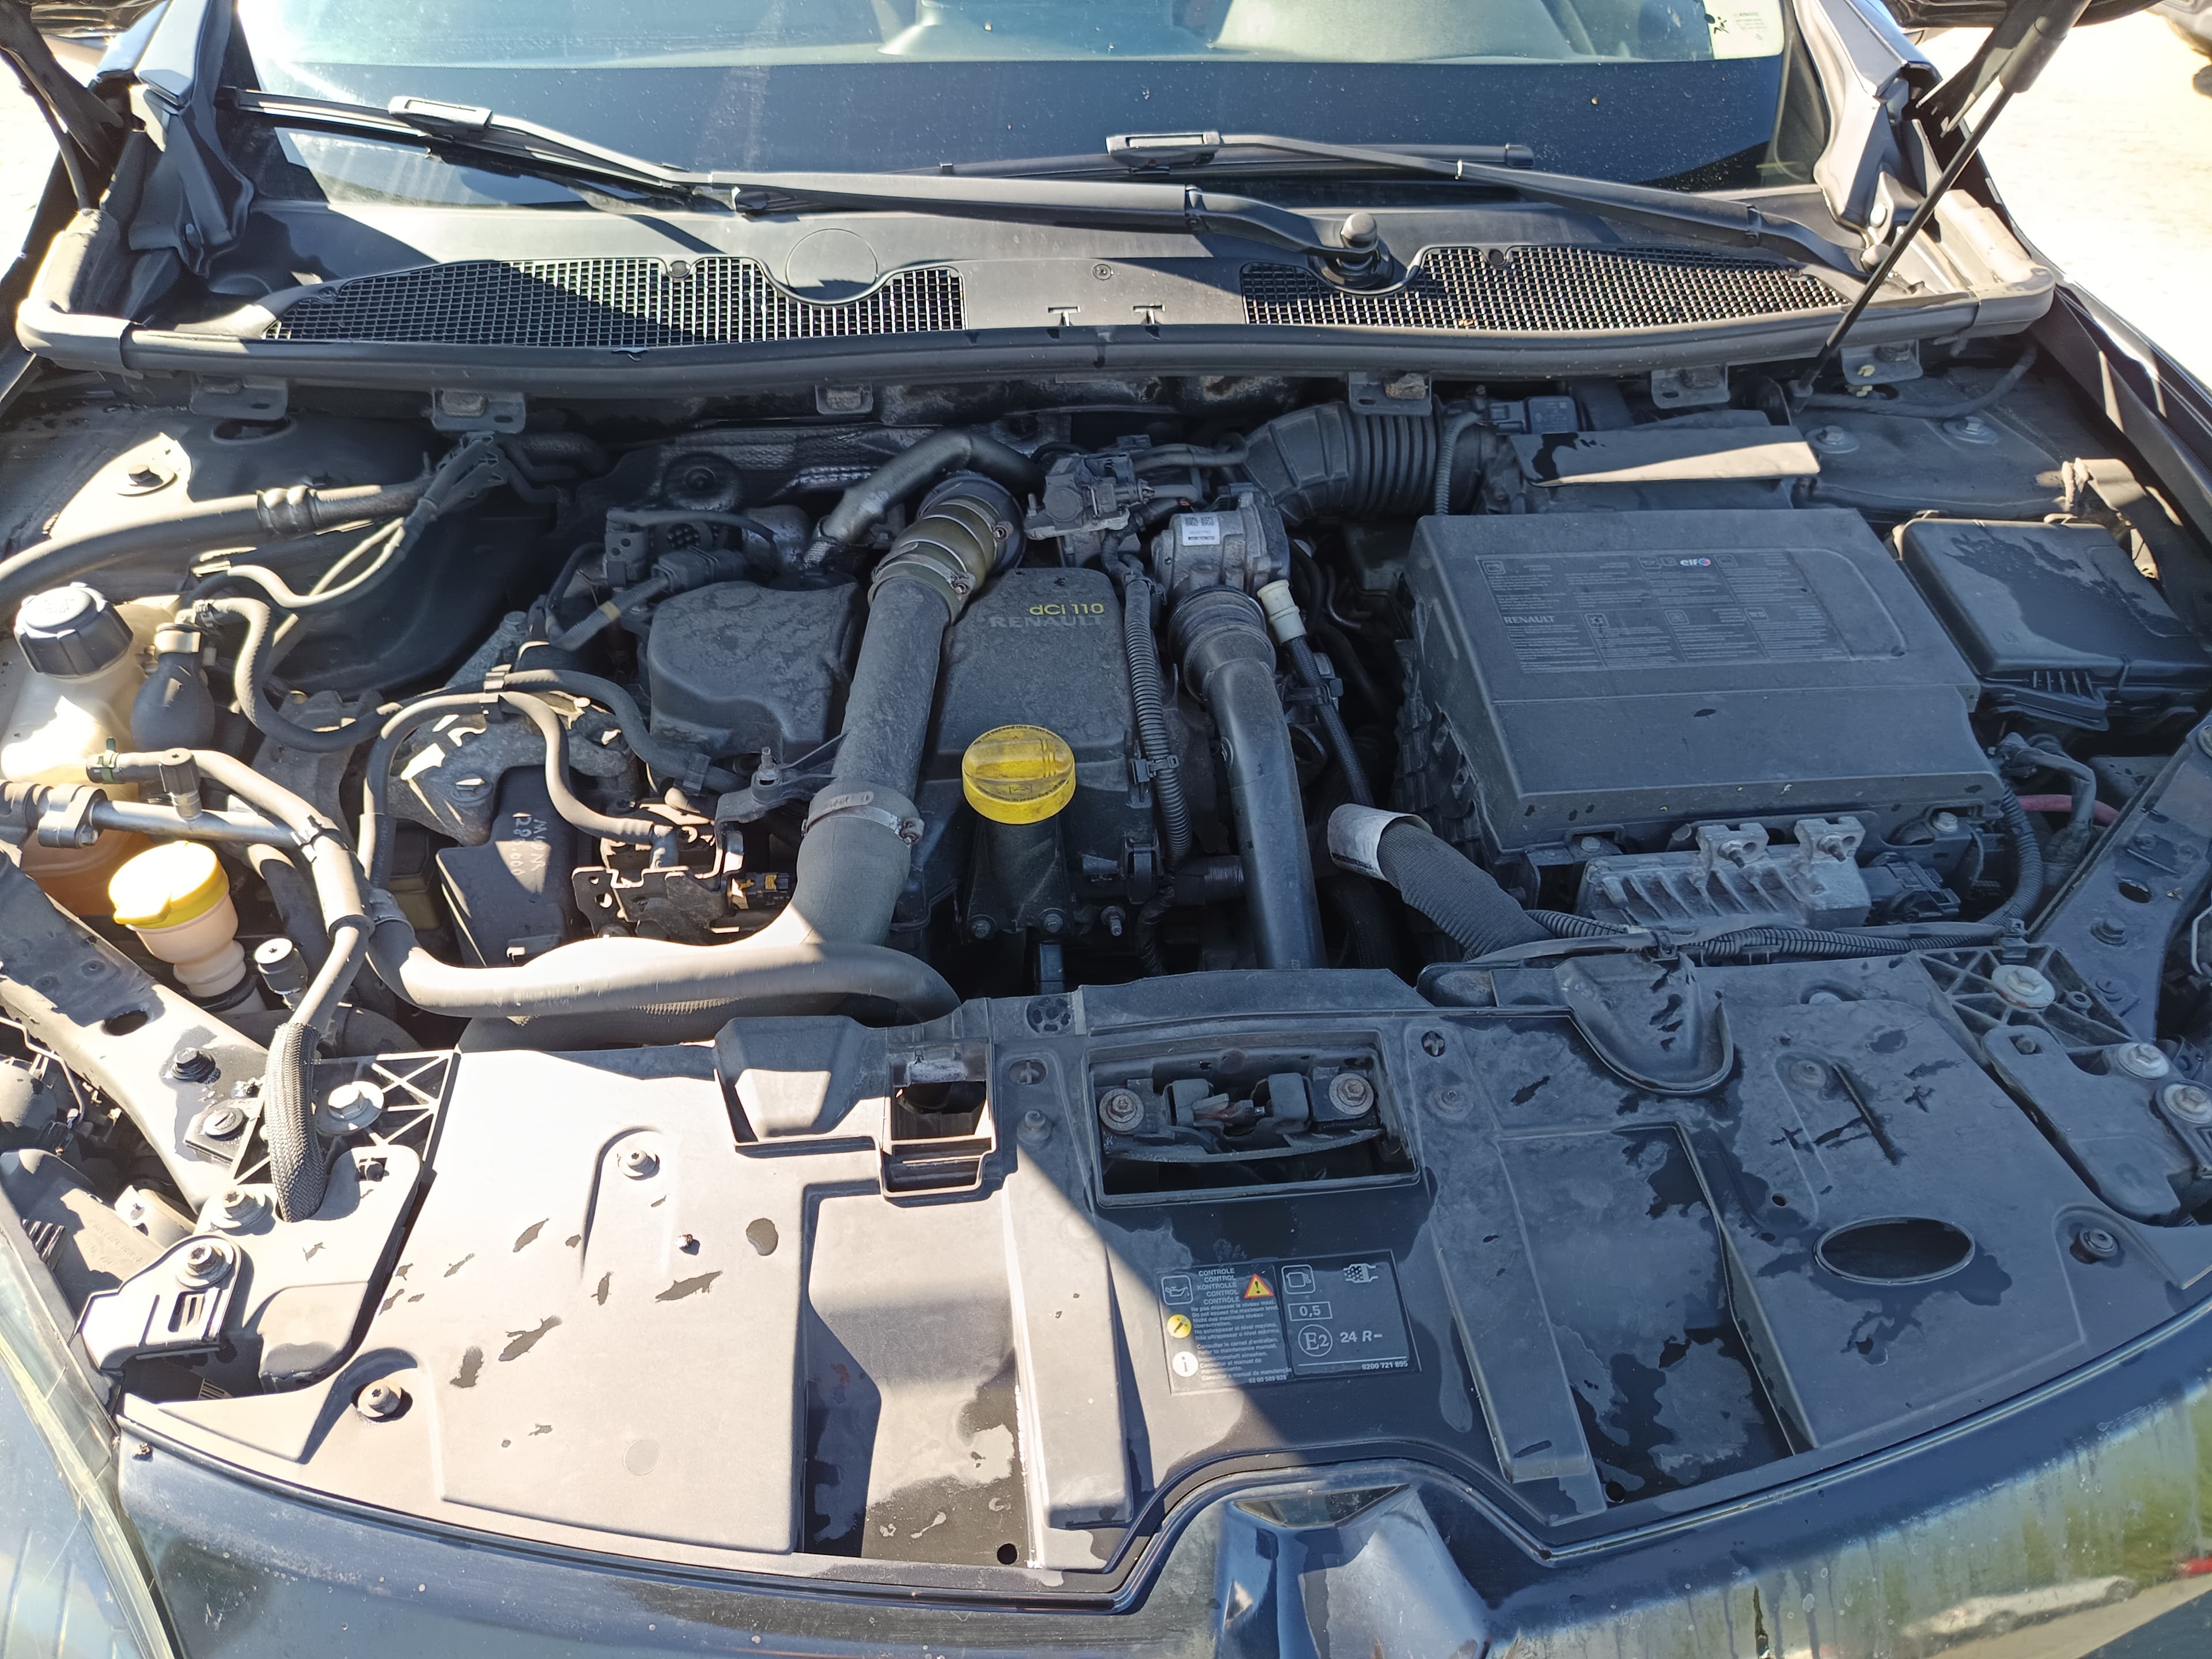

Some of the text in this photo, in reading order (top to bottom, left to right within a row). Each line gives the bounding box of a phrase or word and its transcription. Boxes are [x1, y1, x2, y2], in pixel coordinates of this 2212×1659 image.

[1029, 603, 1105, 615] dCi 110
[989, 615, 1105, 628] RENAULT
[1503, 616, 1555, 624] RENAULT
[991, 726, 1014, 734] exceed
[1199, 1268, 1235, 1277] CONTROLE
[1198, 1282, 1237, 1290] KONTROLLE
[1204, 1296, 1240, 1305] CONTRÔLE
[1300, 1305, 1321, 1317] 0,5
[1304, 1332, 1330, 1350] E2
[1340, 1331, 1358, 1343] 24
